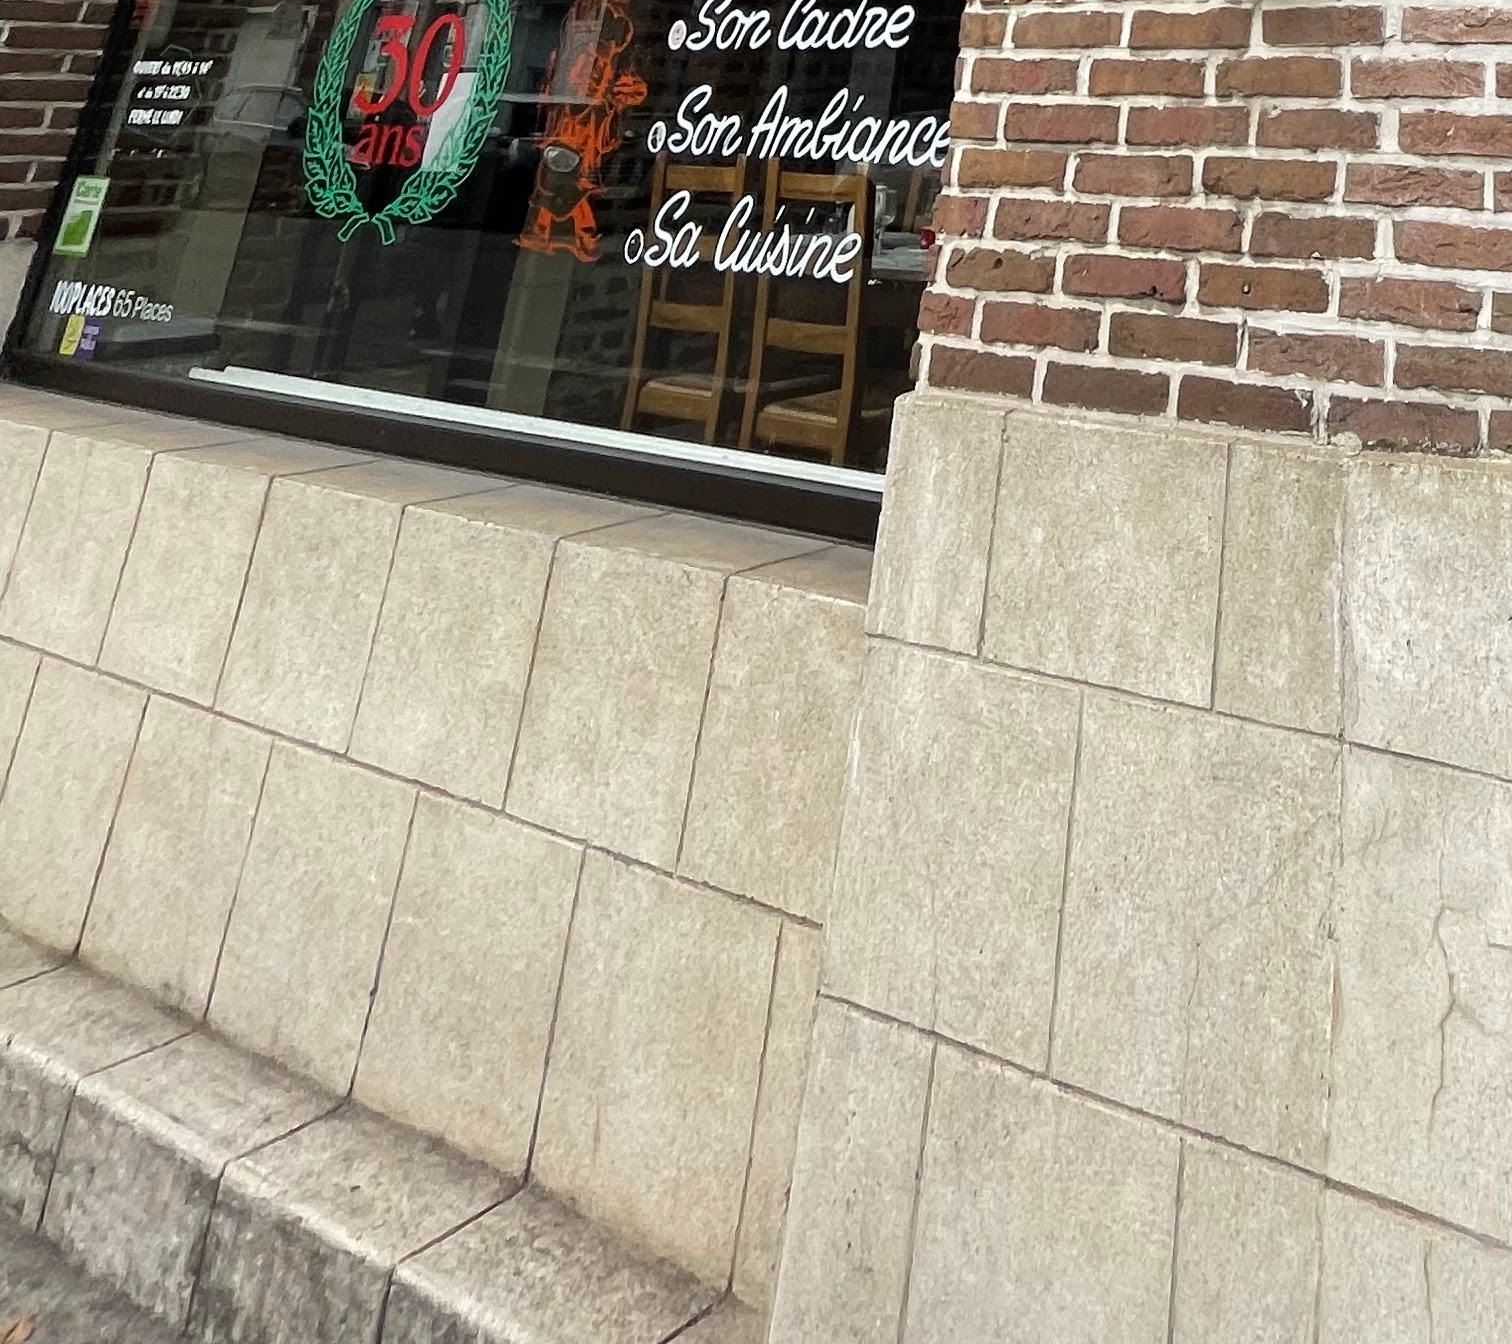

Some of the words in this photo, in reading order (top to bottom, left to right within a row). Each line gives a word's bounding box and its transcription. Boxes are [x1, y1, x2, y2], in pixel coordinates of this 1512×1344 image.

[354, 13, 465, 116] 30
[350, 115, 428, 169] ans
[667, 85, 744, 156] Son
[643, 189, 702, 269] Sa
[714, 194, 863, 284] Cuisine
[112, 288, 137, 318] 65
[131, 296, 175, 323] Places
